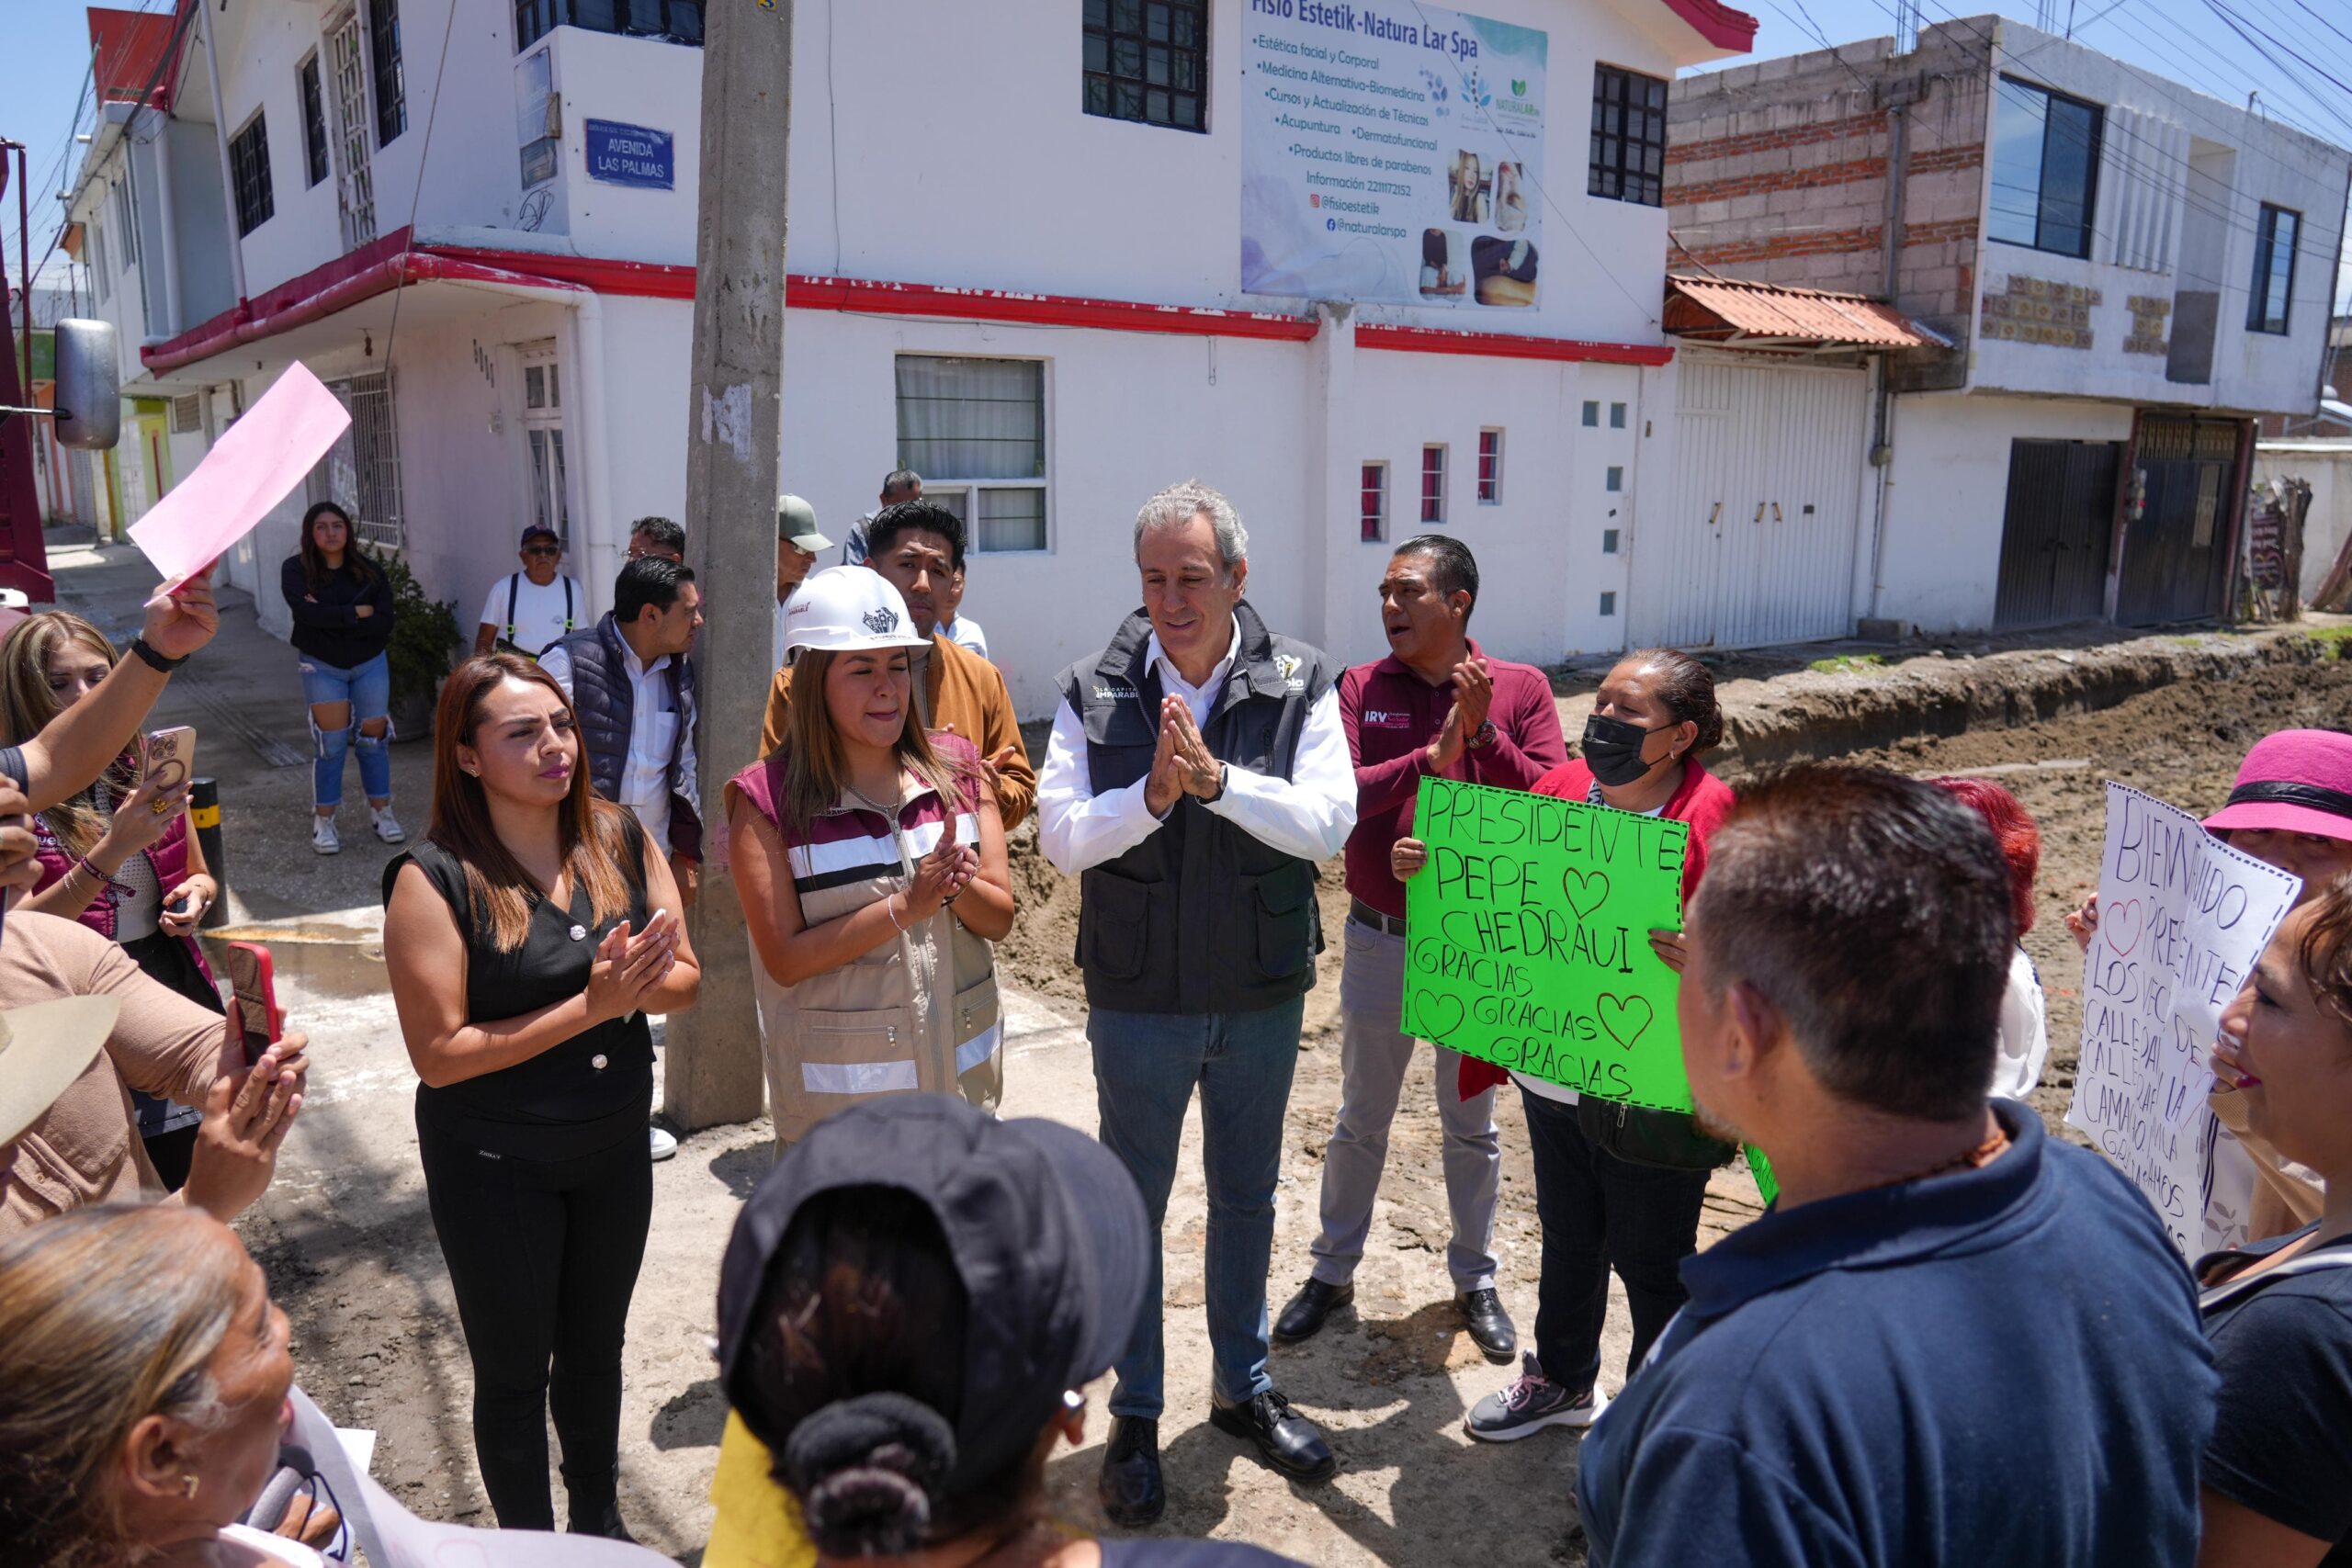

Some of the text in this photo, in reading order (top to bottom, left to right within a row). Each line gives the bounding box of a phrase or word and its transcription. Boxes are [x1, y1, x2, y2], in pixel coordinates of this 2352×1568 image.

[1259, 34, 1379, 70] Estética facial y Corporal
[1423, 24, 1447, 51] Lar
[1452, 30, 1478, 62] Spa
[1262, 60, 1425, 102] Medicina Alternativa-Biomedicina
[1269, 87, 1429, 126] Cursos y Actualización de Técnicas
[1281, 113, 1340, 135] Acupuntura
[607, 138, 654, 158] AVENIDA
[1357, 127, 1438, 152] Dermatofuncional
[598, 155, 664, 178] LAS PALMAS
[1294, 143, 1431, 175] Productos libres de parabenos
[1306, 170, 1364, 191] Información
[1321, 195, 1380, 215] @fisioestetik
[1337, 218, 1407, 239] @naturalarspa
[1095, 691, 1139, 699] IMPARABL
[1425, 781, 1682, 872] PRESIDENTE
[1434, 846, 1543, 907] PEPE
[1441, 910, 1634, 974] CHEDRAUI
[1413, 937, 1533, 998] GRACIAS
[2093, 943, 2138, 1004] LOS
[1473, 994, 1598, 1041] GRACIAS
[2086, 998, 2140, 1053] CALLE
[1490, 1036, 1633, 1098] GRACIAS
[2086, 1039, 2138, 1087] CALLE
